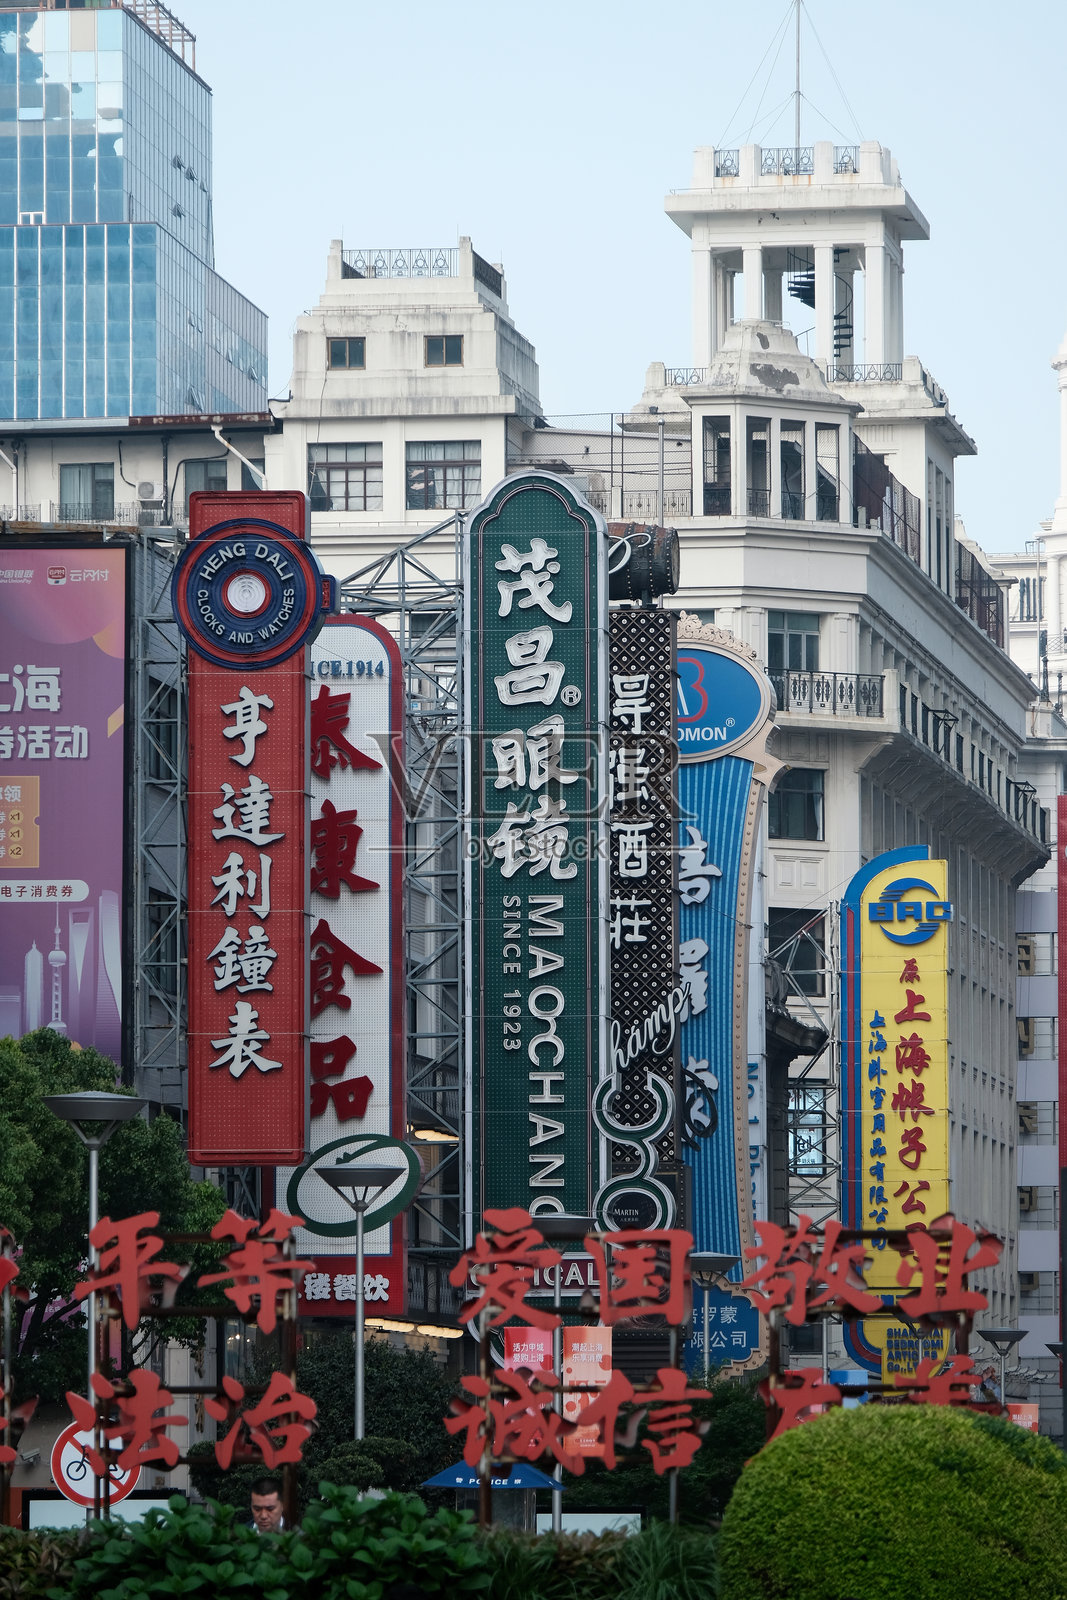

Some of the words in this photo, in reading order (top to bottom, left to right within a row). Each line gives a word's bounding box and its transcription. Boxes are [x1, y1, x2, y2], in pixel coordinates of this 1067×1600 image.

[70, 569, 109, 581] 云闪付
[200, 543, 246, 580] HENG
[254, 544, 294, 581] DALI
[198, 589, 225, 636] CLOCKS
[228, 631, 254, 643] AND
[258, 588, 294, 640] WATCHES
[487, 538, 579, 880] 茂昌眼镜
[1, 885, 73, 898] 电子消费券
[206, 685, 286, 1078] 亨達利鐘表
[310, 684, 384, 1122] 泰康食品
[502, 895, 522, 974] SINCE
[502, 989, 522, 1050] 1923
[298, 1273, 390, 1302] 楼餐饮
[450, 1208, 694, 1331] 爱国
[470, 1262, 601, 1287] ICAL
[740, 1214, 999, 1326] 敬业
[683, 1331, 747, 1348] 限公司
[887, 1328, 943, 1338] SHANAI
[887, 1351, 938, 1360] ARTICES
[66, 1369, 318, 1476] 法治
[444, 1368, 713, 1476] 诚信
